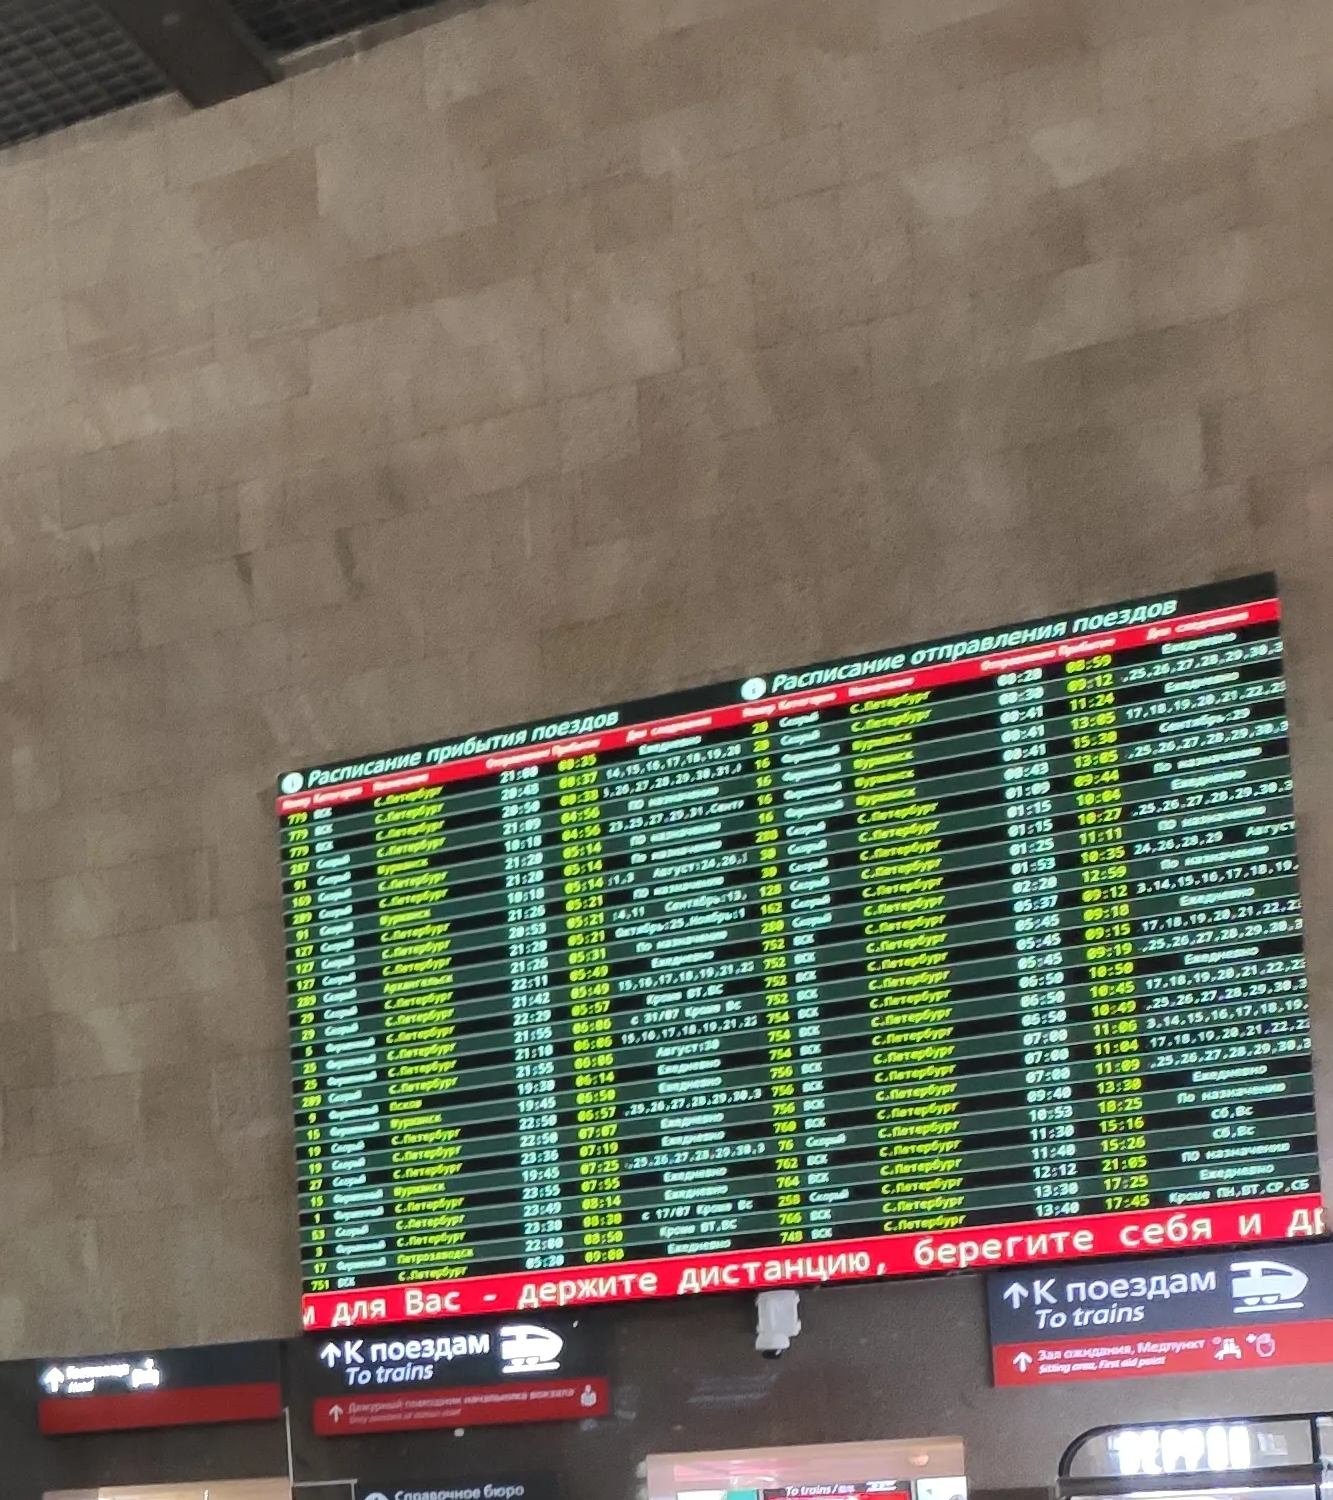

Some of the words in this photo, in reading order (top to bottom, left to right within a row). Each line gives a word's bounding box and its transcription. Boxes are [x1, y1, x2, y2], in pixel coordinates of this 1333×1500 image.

[770, 652, 905, 695] Расписание
[909, 621, 1067, 670] отправления
[1071, 598, 1178, 635] поездов
[306, 749, 421, 788] Расписание
[424, 727, 527, 766] прибытия
[530, 710, 619, 743] поездов
[1079, 826, 1122, 845] 11:11
[1032, 1162, 1078, 1179] 12:12
[1103, 1174, 1149, 1191] 17:25
[1105, 1193, 1150, 1210] 17:45
[330, 1298, 387, 1327] для
[403, 1284, 461, 1315] Вас
[515, 1270, 659, 1310] держите
[912, 1221, 1095, 1271] берегите
[1117, 1210, 1212, 1247] себя
[1237, 1211, 1262, 1236] и
[1033, 1278, 1057, 1305] К
[1066, 1270, 1216, 1303] поездам
[1035, 1310, 1066, 1330] To
[1073, 1304, 1145, 1327] trains
[345, 1339, 364, 1365] К
[371, 1333, 490, 1362] поездам
[1137, 1337, 1206, 1355] Медпункт
[346, 1366, 371, 1386] To
[376, 1363, 434, 1383] trains
[483, 1484, 525, 1500] бюро
